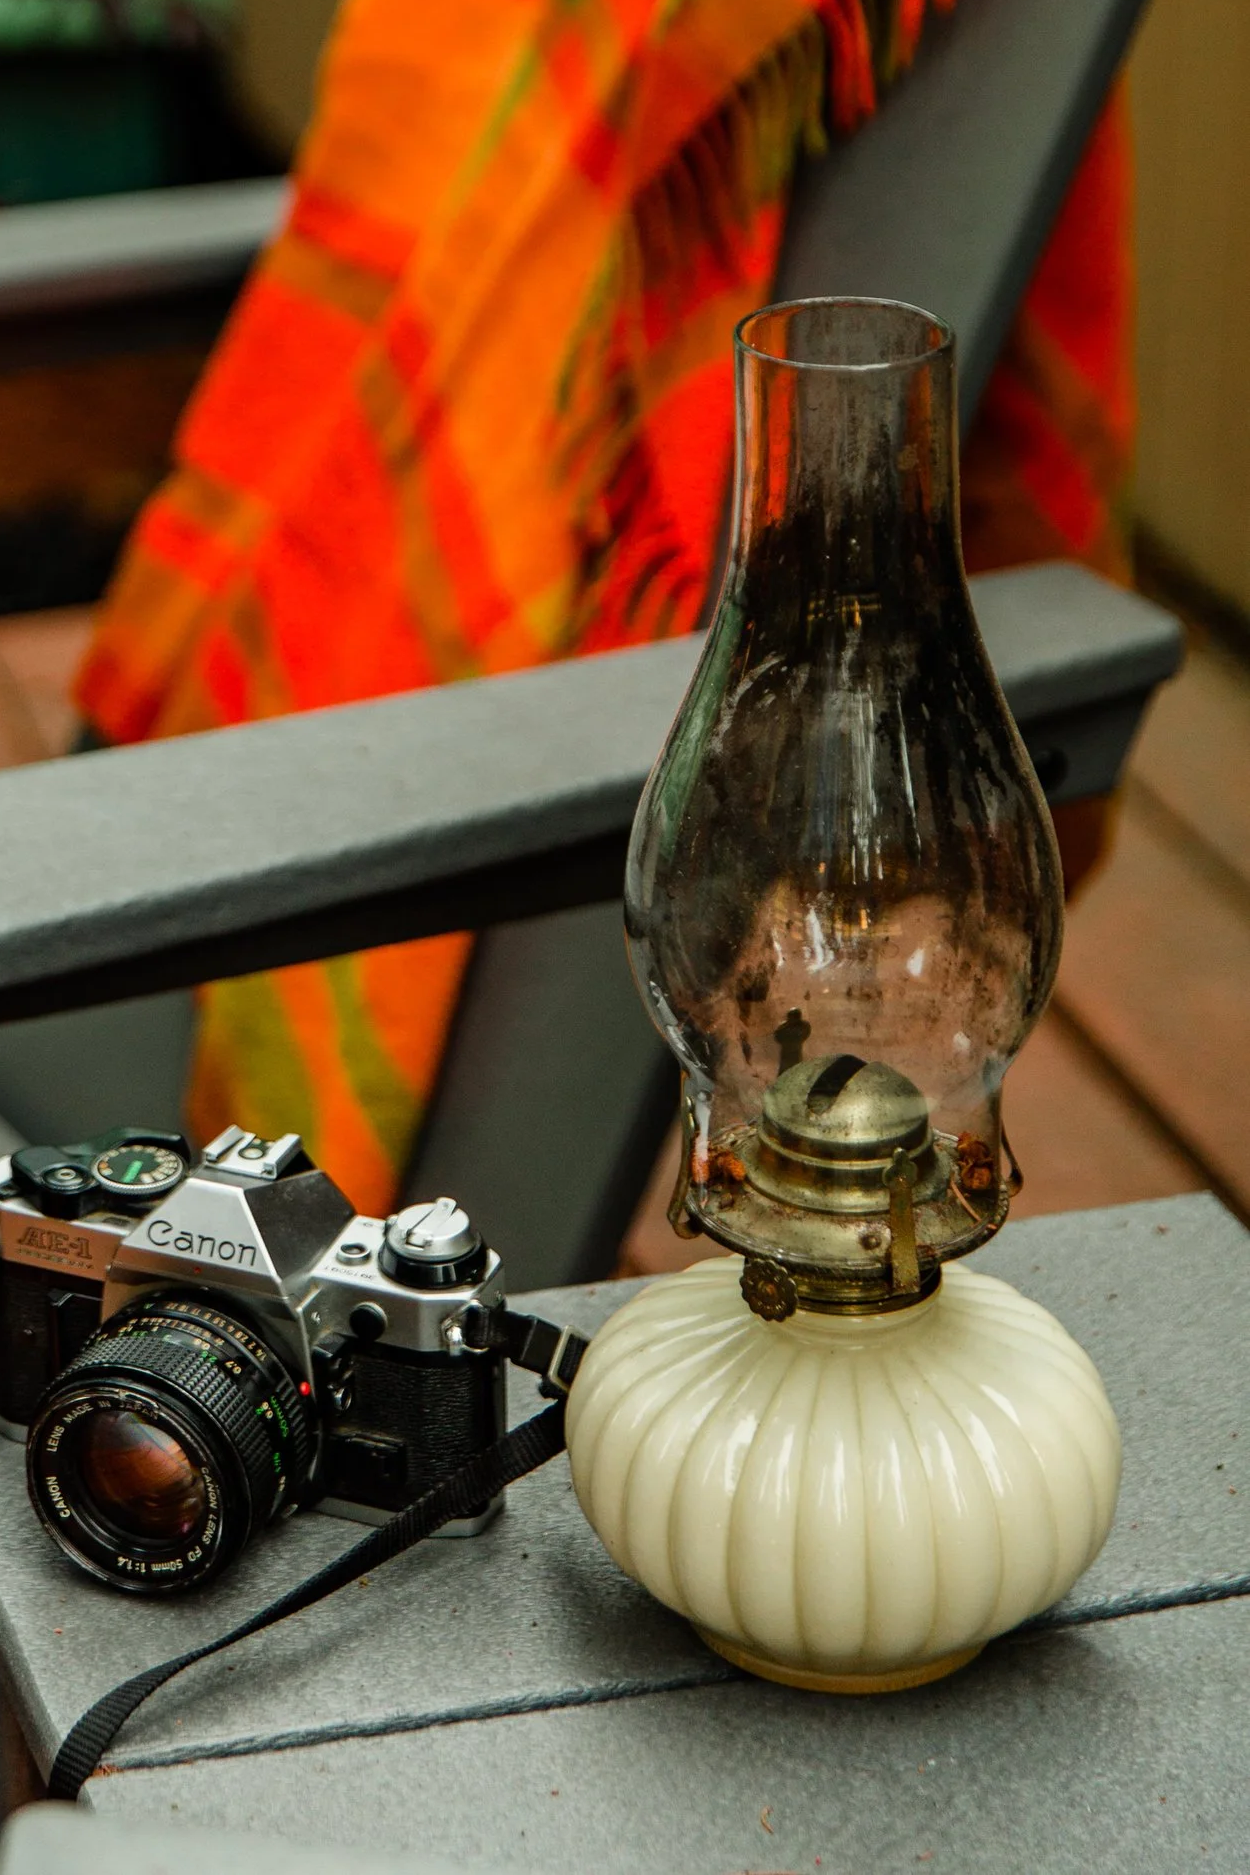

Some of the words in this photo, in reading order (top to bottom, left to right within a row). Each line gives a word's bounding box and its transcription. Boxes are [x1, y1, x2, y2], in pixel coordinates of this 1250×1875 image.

[17, 1226, 93, 1260] AE-1
[147, 1220, 257, 1267] Canon
[224, 1360, 242, 1374] 0.7
[62, 1403, 94, 1424] MADE
[97, 1400, 111, 1408] IN
[46, 1425, 66, 1452] LENS
[46, 1476, 70, 1518] CANON
[202, 1467, 218, 1509] CANON
[202, 1514, 218, 1544] LENS
[151, 1558, 184, 1571] 50mm
[187, 1546, 203, 1562] FD
